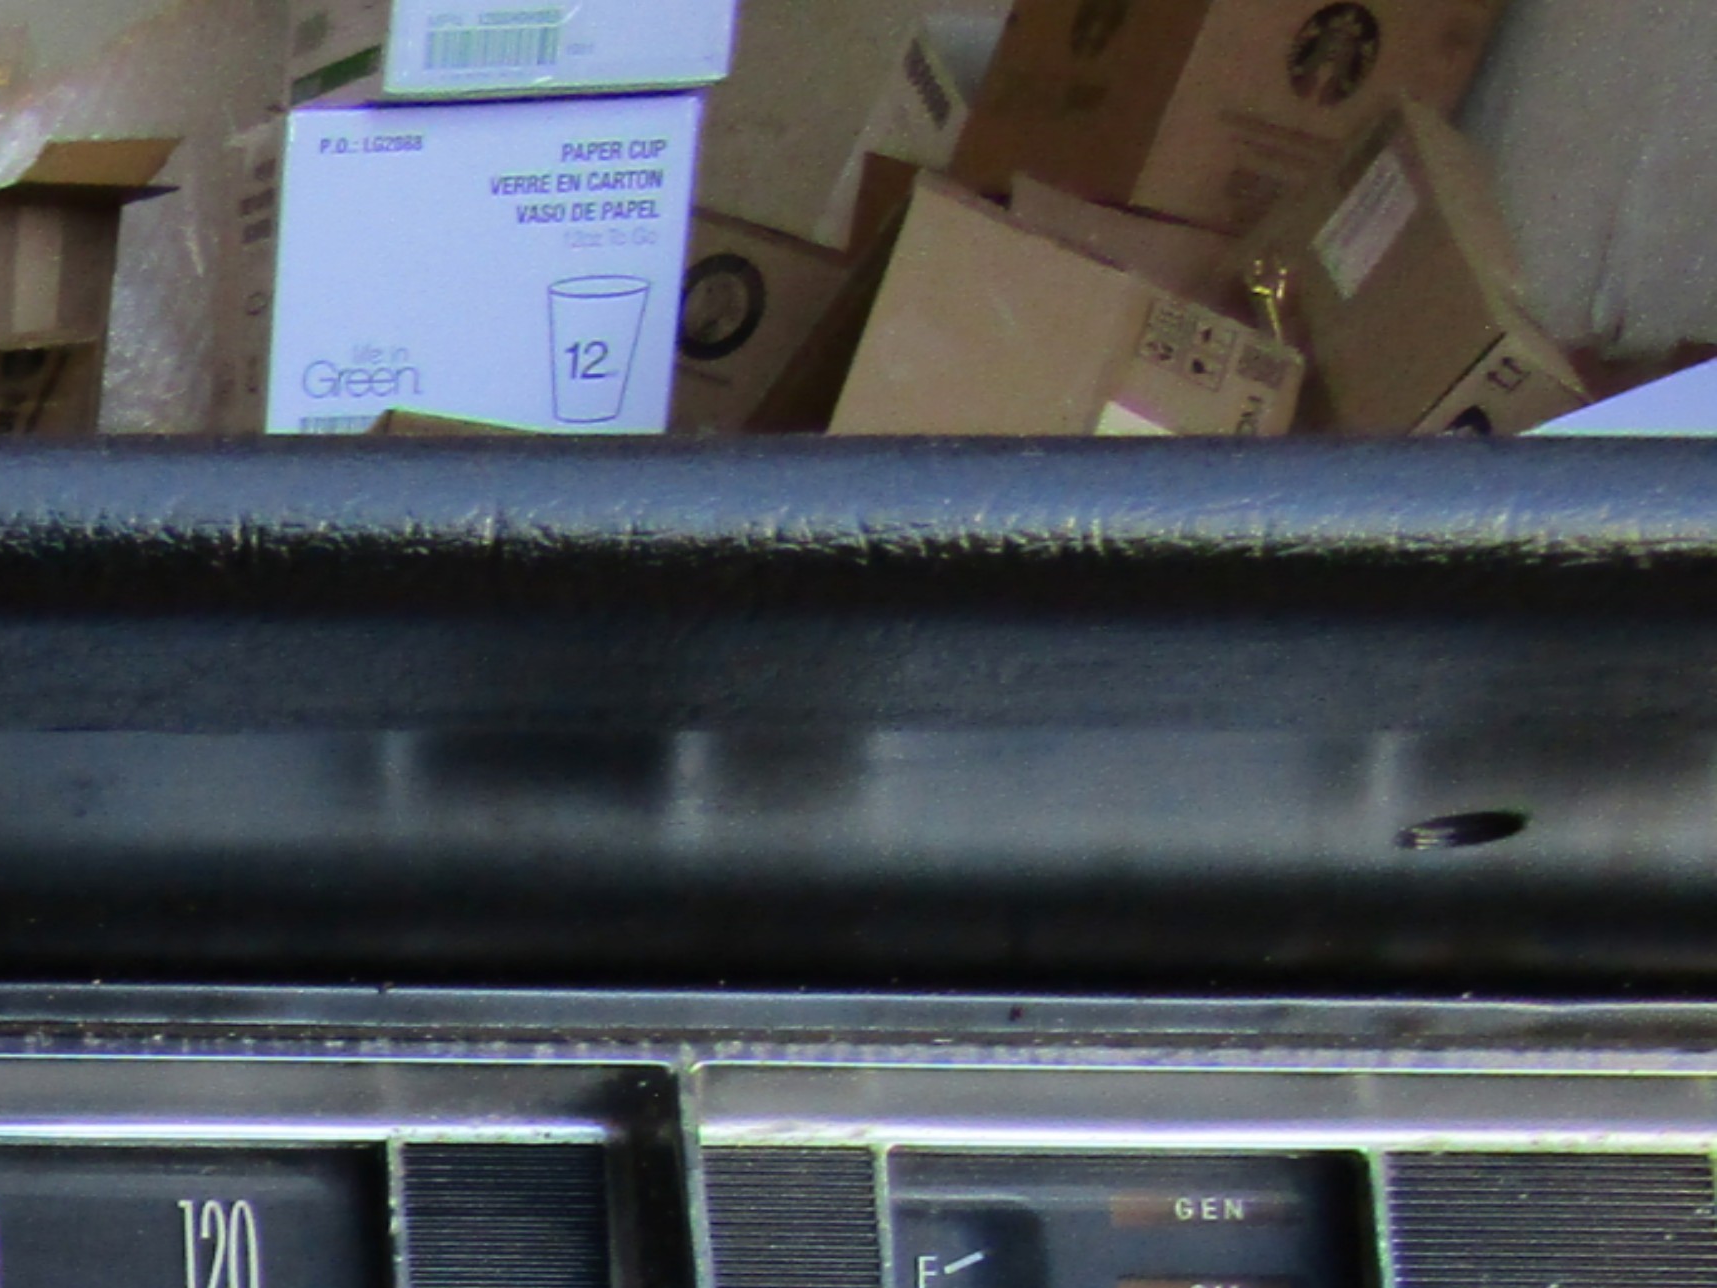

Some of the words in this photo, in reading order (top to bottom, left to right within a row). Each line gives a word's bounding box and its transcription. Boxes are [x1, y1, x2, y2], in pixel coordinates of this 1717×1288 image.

[561, 141, 622, 162] PAPER
[628, 138, 667, 160] CUP
[490, 174, 551, 195] VERRE
[557, 172, 581, 193] EN
[587, 169, 664, 191] CARTON
[516, 203, 565, 224] VASO
[571, 201, 596, 222] DE
[601, 199, 660, 221] PAPEL
[302, 359, 423, 399] Green
[1174, 1197, 1246, 1221] GEN
